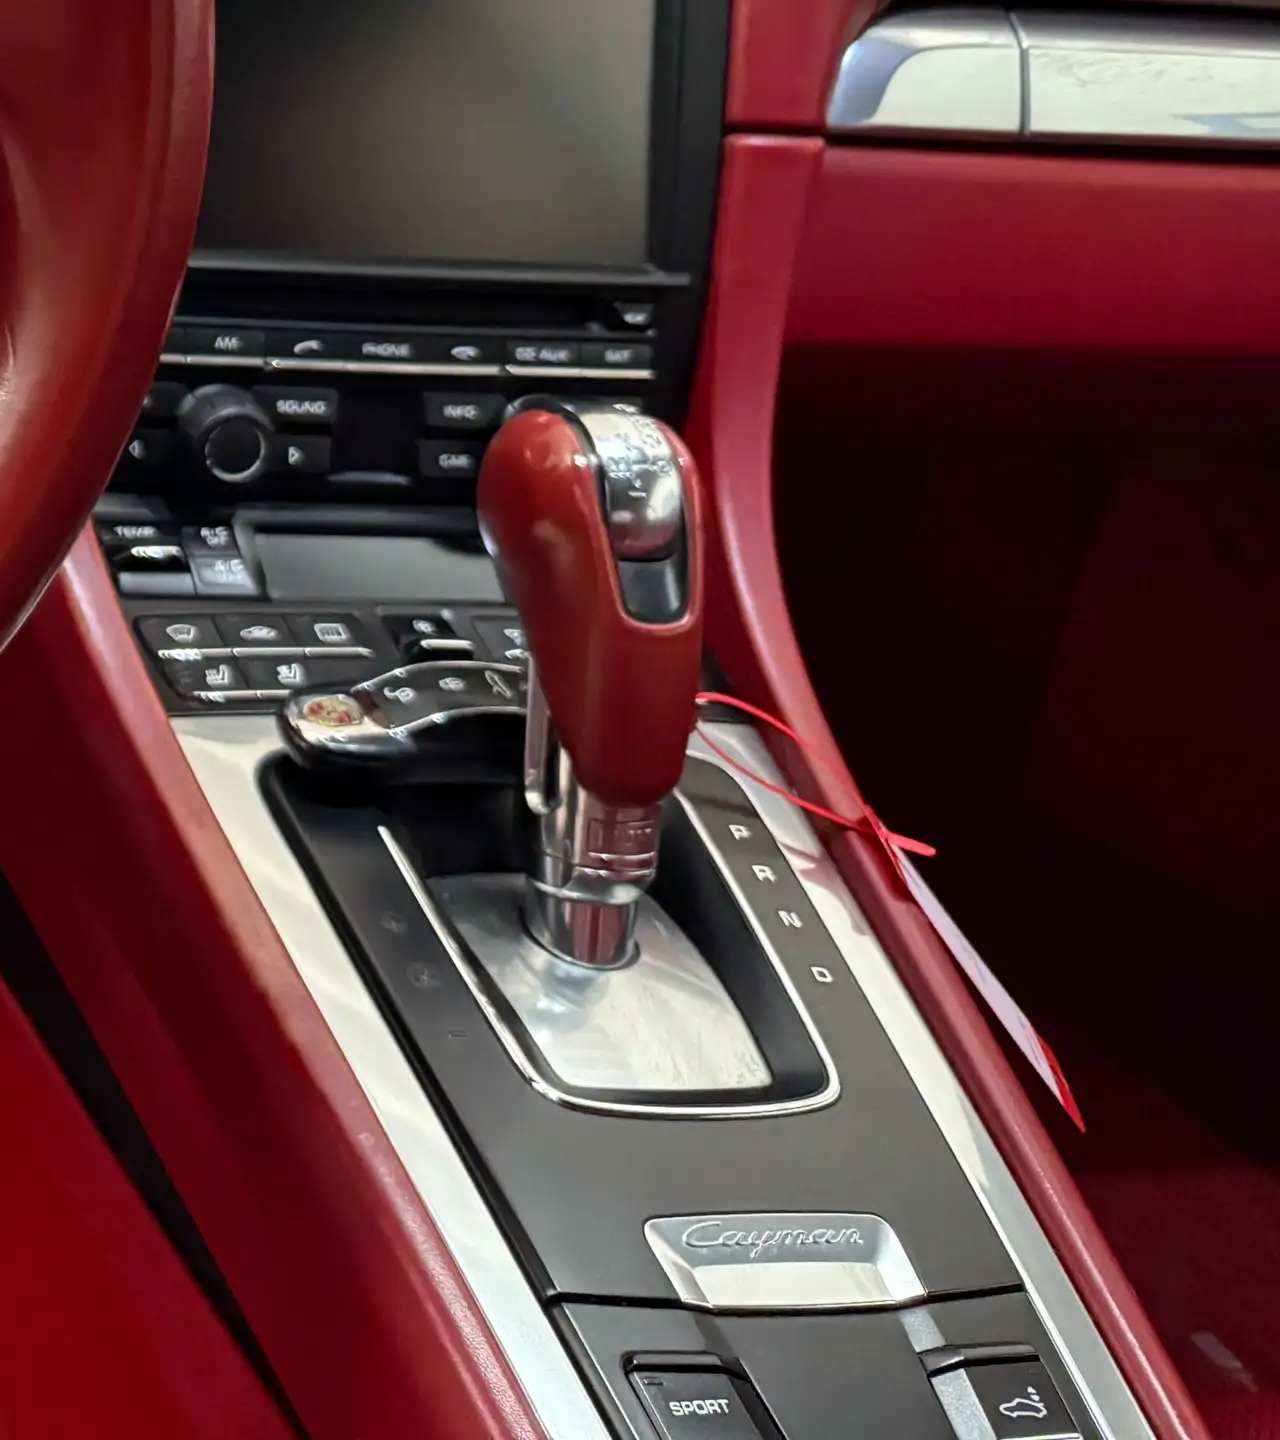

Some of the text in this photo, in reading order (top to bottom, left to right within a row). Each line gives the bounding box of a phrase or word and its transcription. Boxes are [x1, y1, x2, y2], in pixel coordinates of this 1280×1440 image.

[361, 341, 412, 359] PHONE
[275, 398, 327, 415] SOUND
[728, 824, 752, 841] P
[751, 864, 778, 883] R
[777, 910, 804, 929] N
[810, 966, 834, 983] D
[681, 1220, 864, 1259] Cayman
[668, 1398, 730, 1417] SPORT
